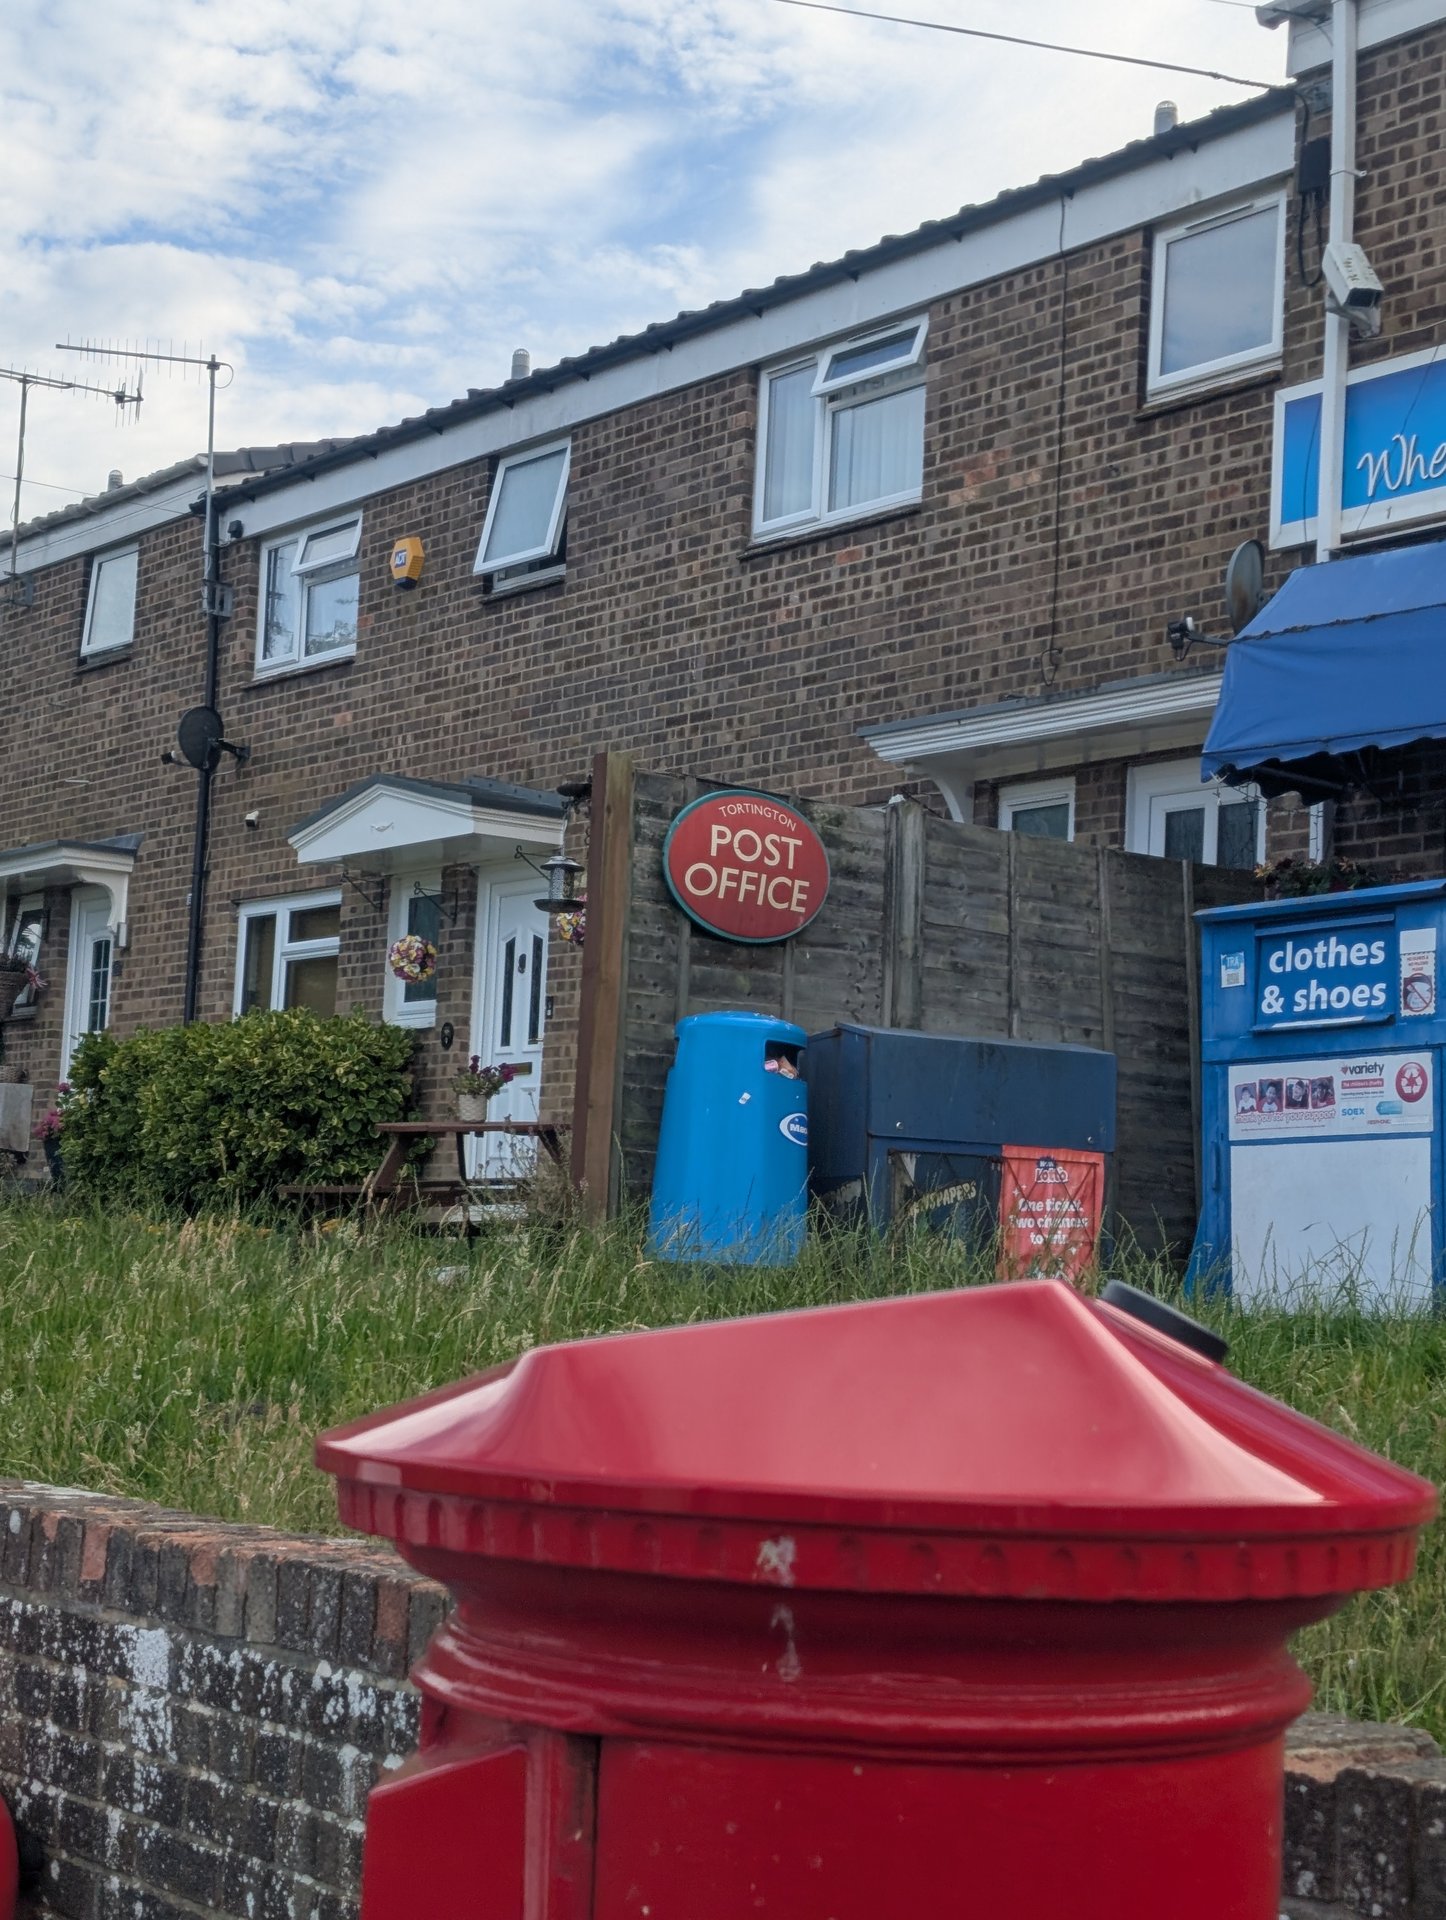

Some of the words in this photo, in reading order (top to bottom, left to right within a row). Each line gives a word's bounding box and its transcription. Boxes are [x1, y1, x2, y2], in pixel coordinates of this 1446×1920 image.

[1356, 434, 1446, 497] Whe
[718, 803, 797, 832] TORTINGTON
[710, 824, 803, 870] POST
[684, 862, 810, 913] OFFICE
[1269, 936, 1385, 973] clothes
[1261, 985, 1284, 1014] &
[1293, 979, 1387, 1012] shoes
[1348, 1061, 1385, 1076] variety
[1257, 1112, 1272, 1125] you
[1284, 1111, 1304, 1124] your
[1304, 1108, 1336, 1122] support
[1341, 1107, 1365, 1116] SOEX
[1018, 1198, 1044, 1212] One
[1009, 1214, 1035, 1228] Two
[1030, 1231, 1044, 1245] to
